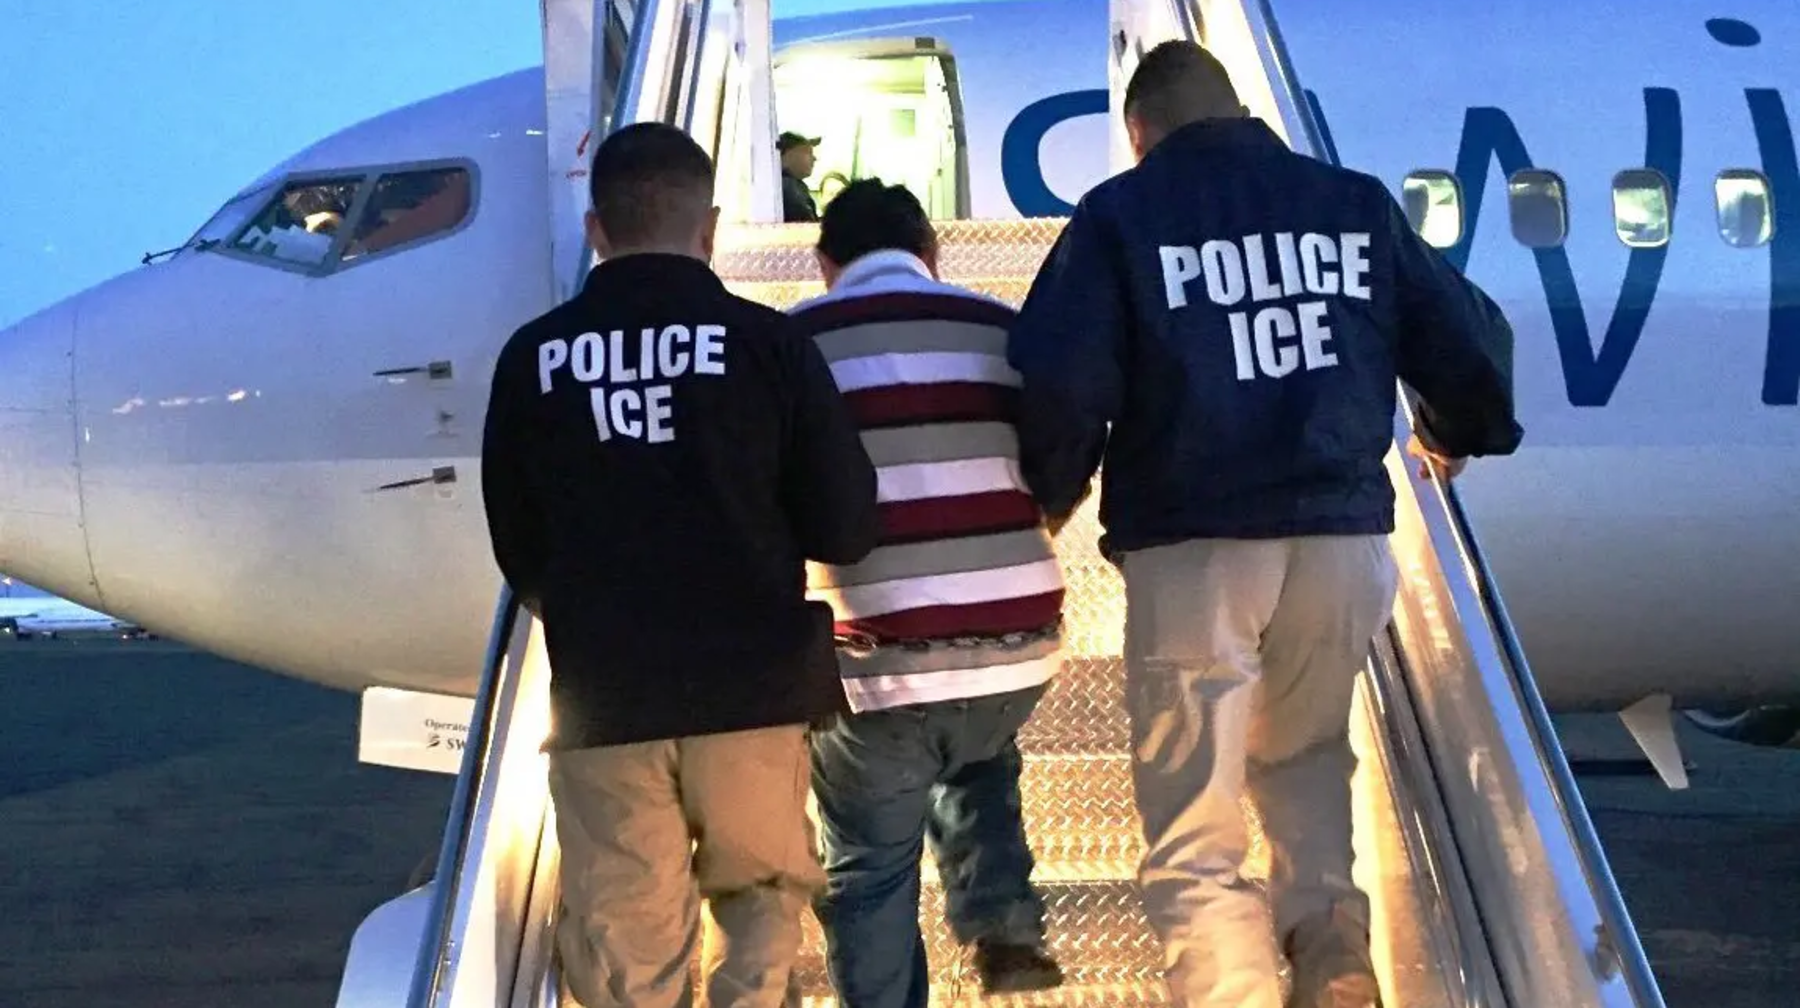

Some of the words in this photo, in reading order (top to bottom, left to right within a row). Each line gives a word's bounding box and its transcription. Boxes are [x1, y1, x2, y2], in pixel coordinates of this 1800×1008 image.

[1158, 231, 1372, 310] POLICE
[538, 324, 727, 394] POLICE
[1228, 300, 1339, 381] ICE
[590, 384, 675, 443] ICE
